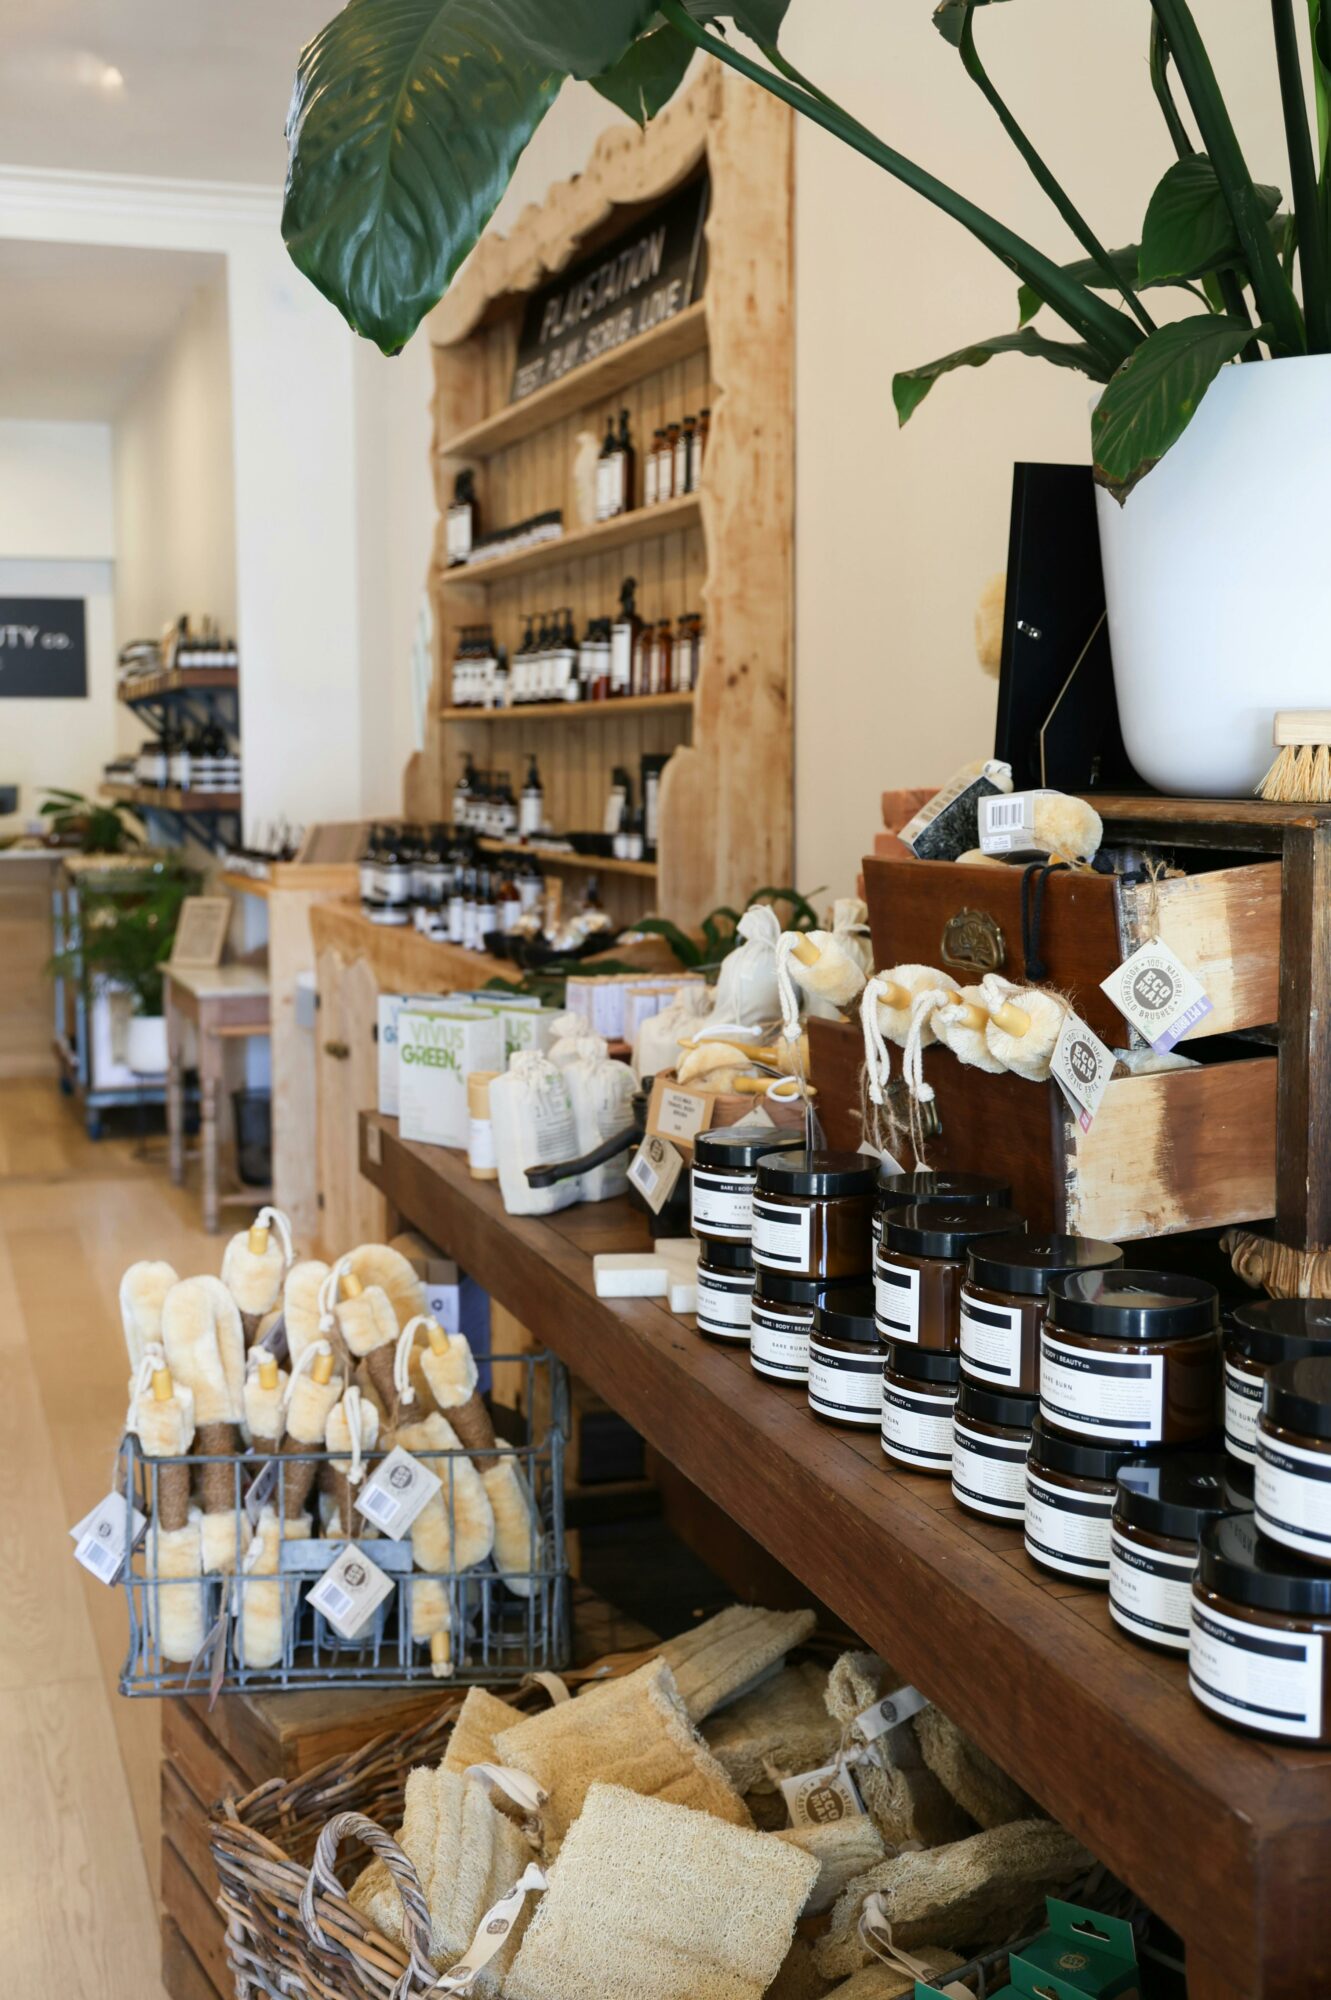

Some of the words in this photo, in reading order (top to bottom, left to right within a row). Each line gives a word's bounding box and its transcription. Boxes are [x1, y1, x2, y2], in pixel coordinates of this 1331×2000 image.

[539, 225, 667, 344] PLAYSTATION
[1143, 970, 1172, 999] ECO
[1166, 963, 1183, 998] NATURAL
[1123, 966, 1140, 1012] HOUSEHOLD
[1138, 1006, 1175, 1020] BRUSHES
[1135, 980, 1164, 1008] MAX
[410, 1022, 465, 1049] VIVUS
[401, 1045, 456, 1070] GREEN
[1074, 1043, 1095, 1069] ECO
[1082, 1034, 1104, 1071] NATURAL
[1064, 1056, 1082, 1091] PLASTIC
[1085, 1083, 1099, 1094] FREE
[1072, 1055, 1092, 1080] MAX
[720, 1184, 734, 1192] BARE
[707, 1281, 722, 1290] BEAUTY
[761, 1319, 772, 1328] BARE
[775, 1322, 790, 1331] BODY
[772, 1342, 787, 1350] BARE
[818, 1356, 834, 1366] BEAUTY
[1059, 1356, 1082, 1368] BEAUTY
[1055, 1380, 1073, 1391] BURN
[889, 1393, 906, 1407] BEAUTY
[1238, 1411, 1257, 1424] BURN
[956, 1435, 971, 1448] BEAUTY
[1265, 1451, 1286, 1469] BEAUTY
[1032, 1488, 1050, 1503] BEAUTY
[1124, 1551, 1147, 1569] BEAUTY
[1203, 1621, 1228, 1640] BEAUTY
[810, 1795, 830, 1824] MAX
[819, 1788, 840, 1820] ECO
